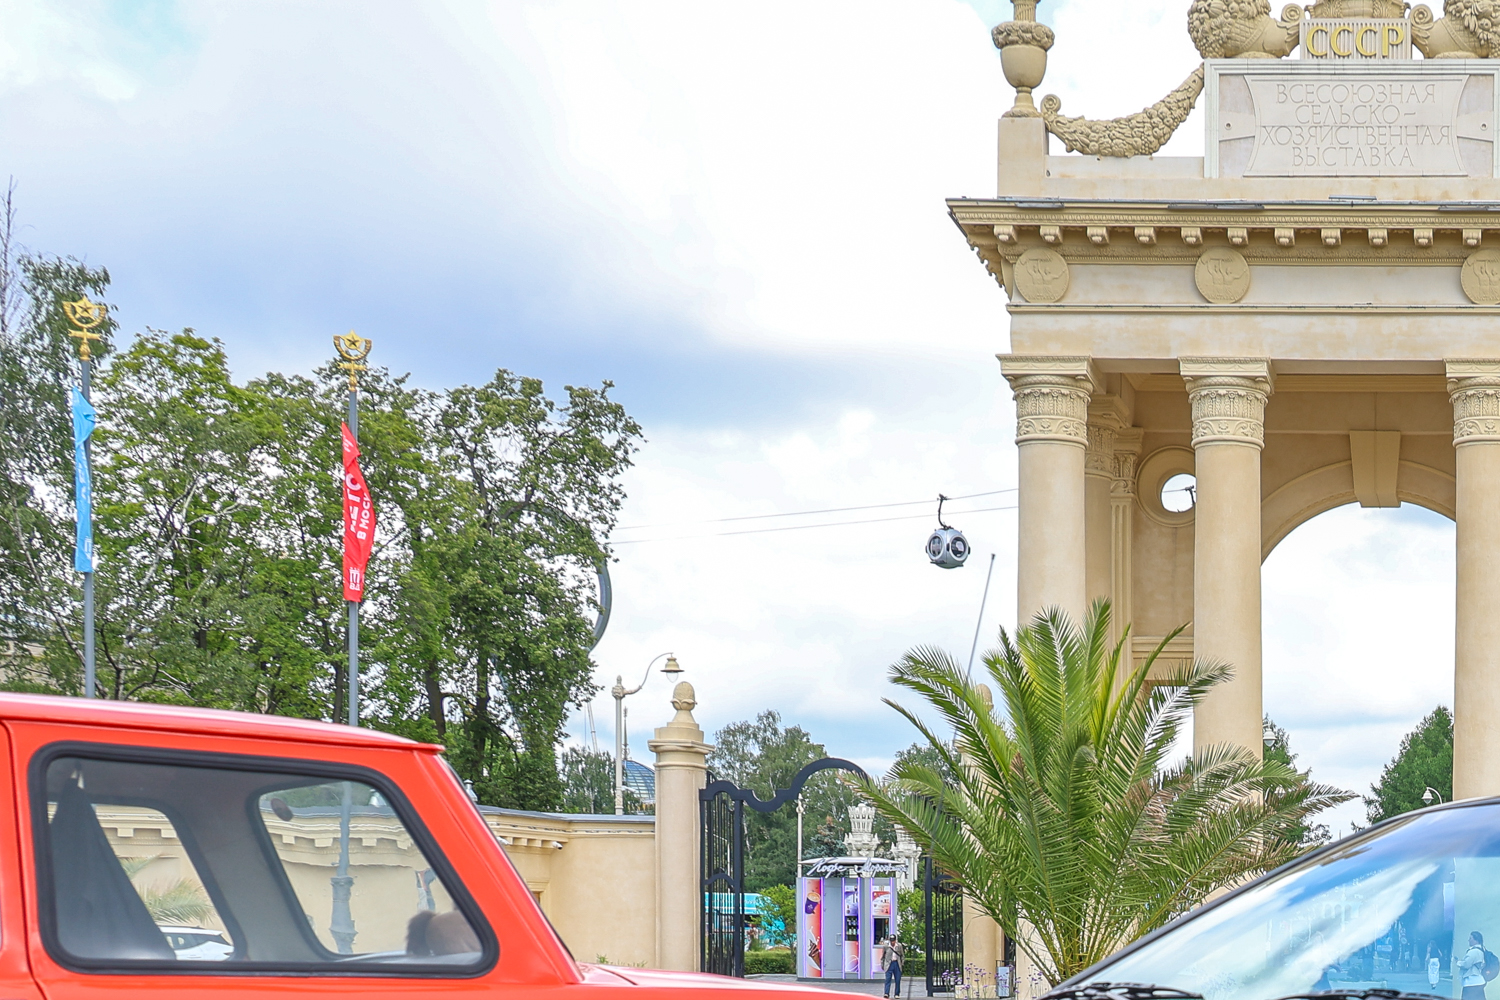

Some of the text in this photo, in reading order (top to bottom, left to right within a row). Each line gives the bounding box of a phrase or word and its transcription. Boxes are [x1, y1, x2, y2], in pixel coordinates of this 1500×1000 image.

[1306, 25, 1404, 57] СССР
[1276, 84, 1436, 104] ВСЕСОЮЗНАЯ
[1262, 125, 1450, 146] ХОЗЯЙСТВЕННАЯ
[1292, 147, 1414, 167] ВЫСТАВКА
